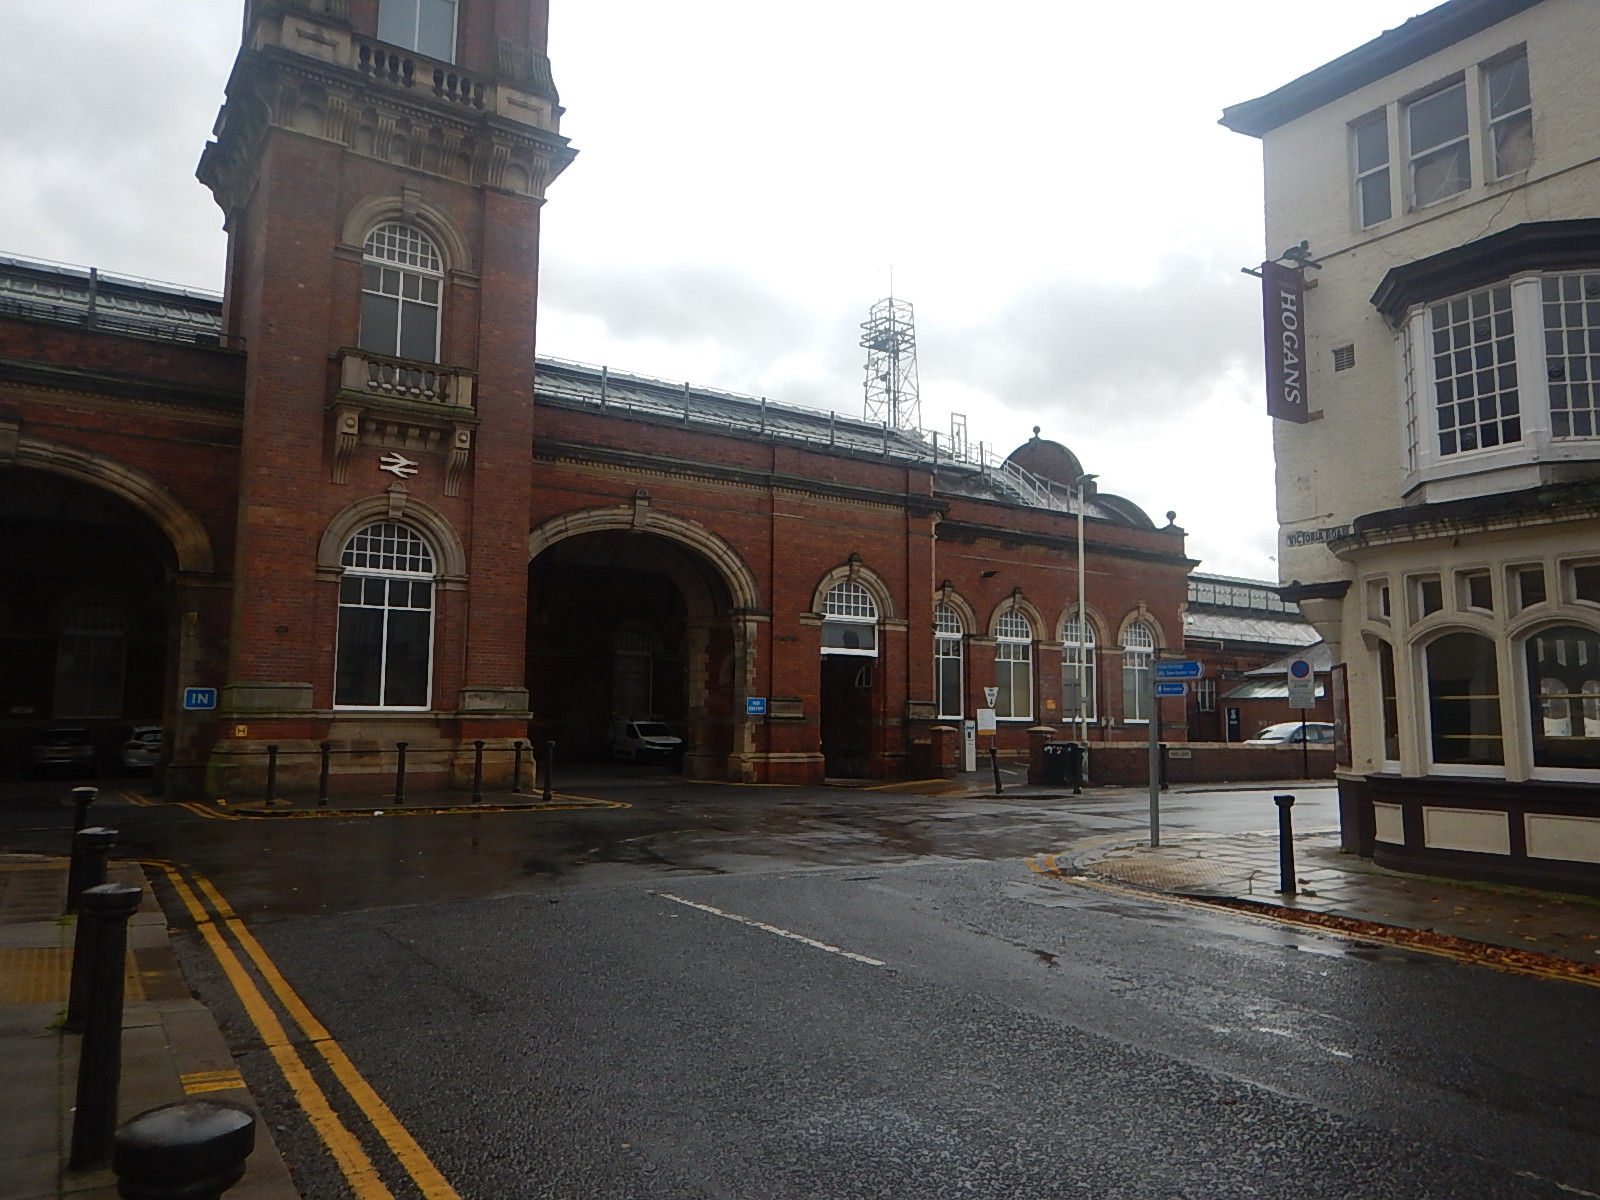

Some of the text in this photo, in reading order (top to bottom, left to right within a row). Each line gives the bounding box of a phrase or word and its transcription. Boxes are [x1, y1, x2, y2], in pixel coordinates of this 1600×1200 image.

[1280, 290, 1301, 404] HOGANS
[1287, 531, 1324, 546] VICTORIA
[191, 692, 209, 705] IN
[237, 726, 246, 736] H
